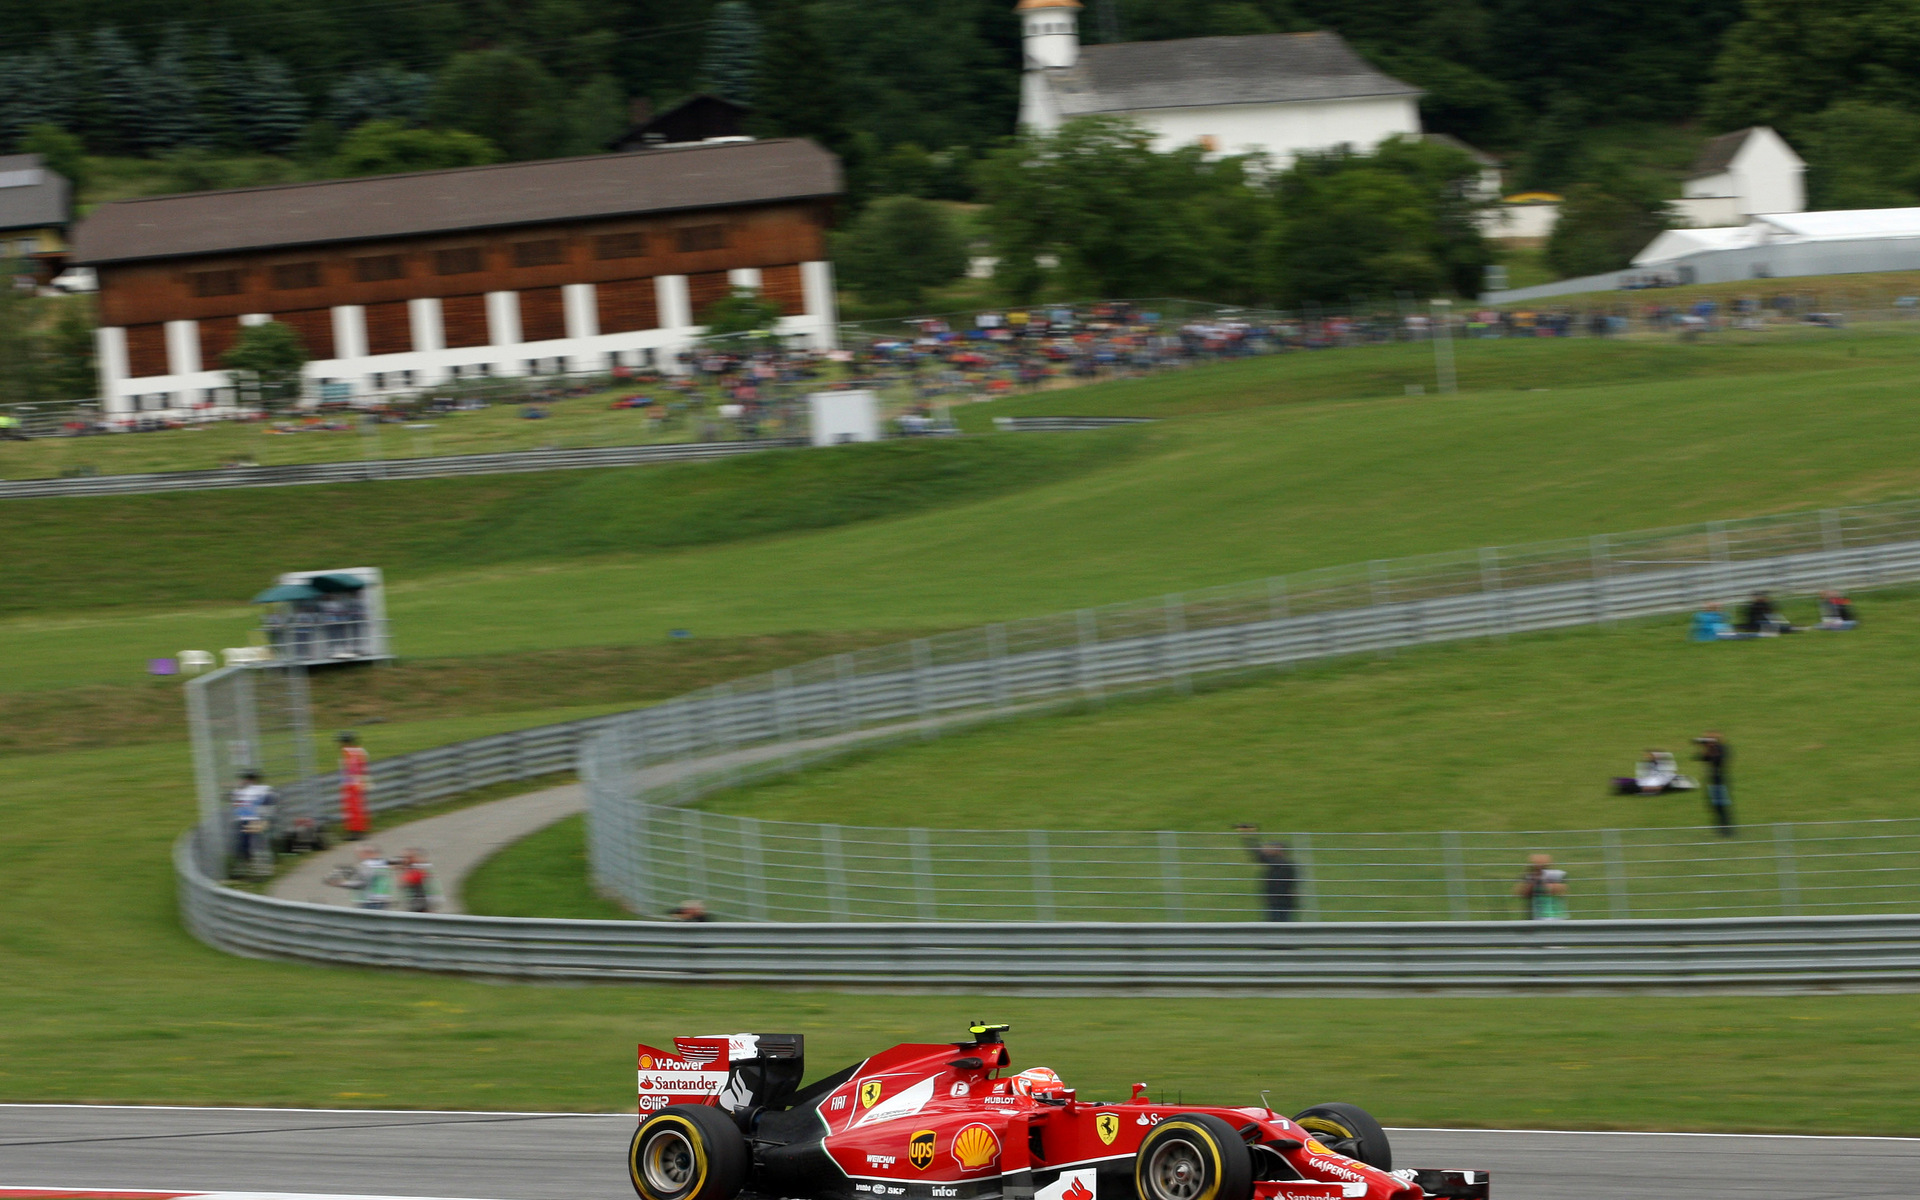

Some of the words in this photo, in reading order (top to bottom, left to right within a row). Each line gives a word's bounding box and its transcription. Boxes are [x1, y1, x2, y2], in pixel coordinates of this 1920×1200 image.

[654, 1058, 704, 1071] V-Power
[655, 1075, 718, 1090] Santander
[830, 1095, 848, 1111] FIAT
[984, 1096, 1016, 1105] HUBLOT
[1268, 1119, 1290, 1131] 7
[911, 1142, 933, 1164] ups
[887, 1186, 906, 1195] SKF
[931, 1186, 958, 1197] infor
